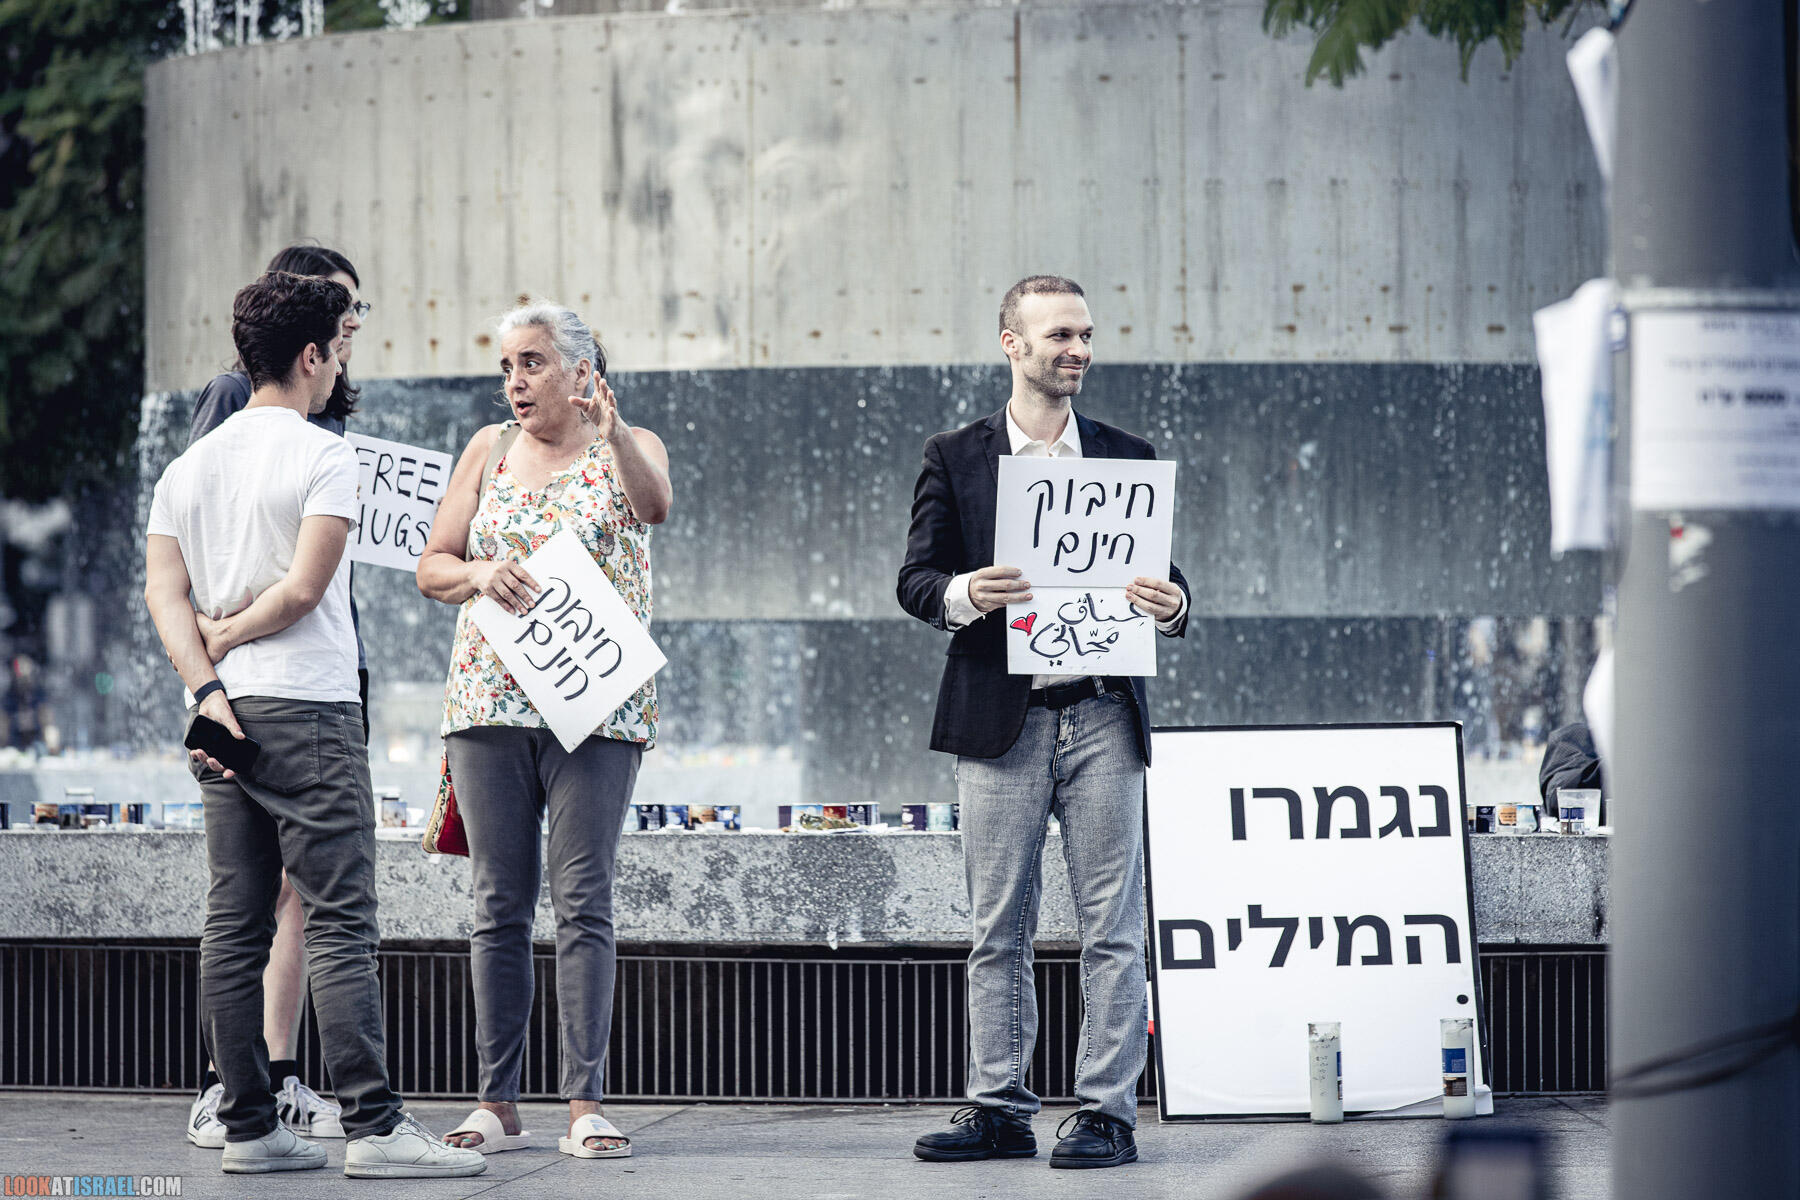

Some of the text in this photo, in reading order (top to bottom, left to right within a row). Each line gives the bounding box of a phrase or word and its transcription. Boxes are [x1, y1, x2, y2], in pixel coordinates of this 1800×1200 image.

[1026, 478, 1155, 549] חיבוק
[1053, 531, 1135, 573] חינם
[514, 618, 589, 701] חינם
[518, 576, 622, 679] חיבוק
[1229, 784, 1452, 841] נגמרו
[1158, 903, 1462, 970] המילים
